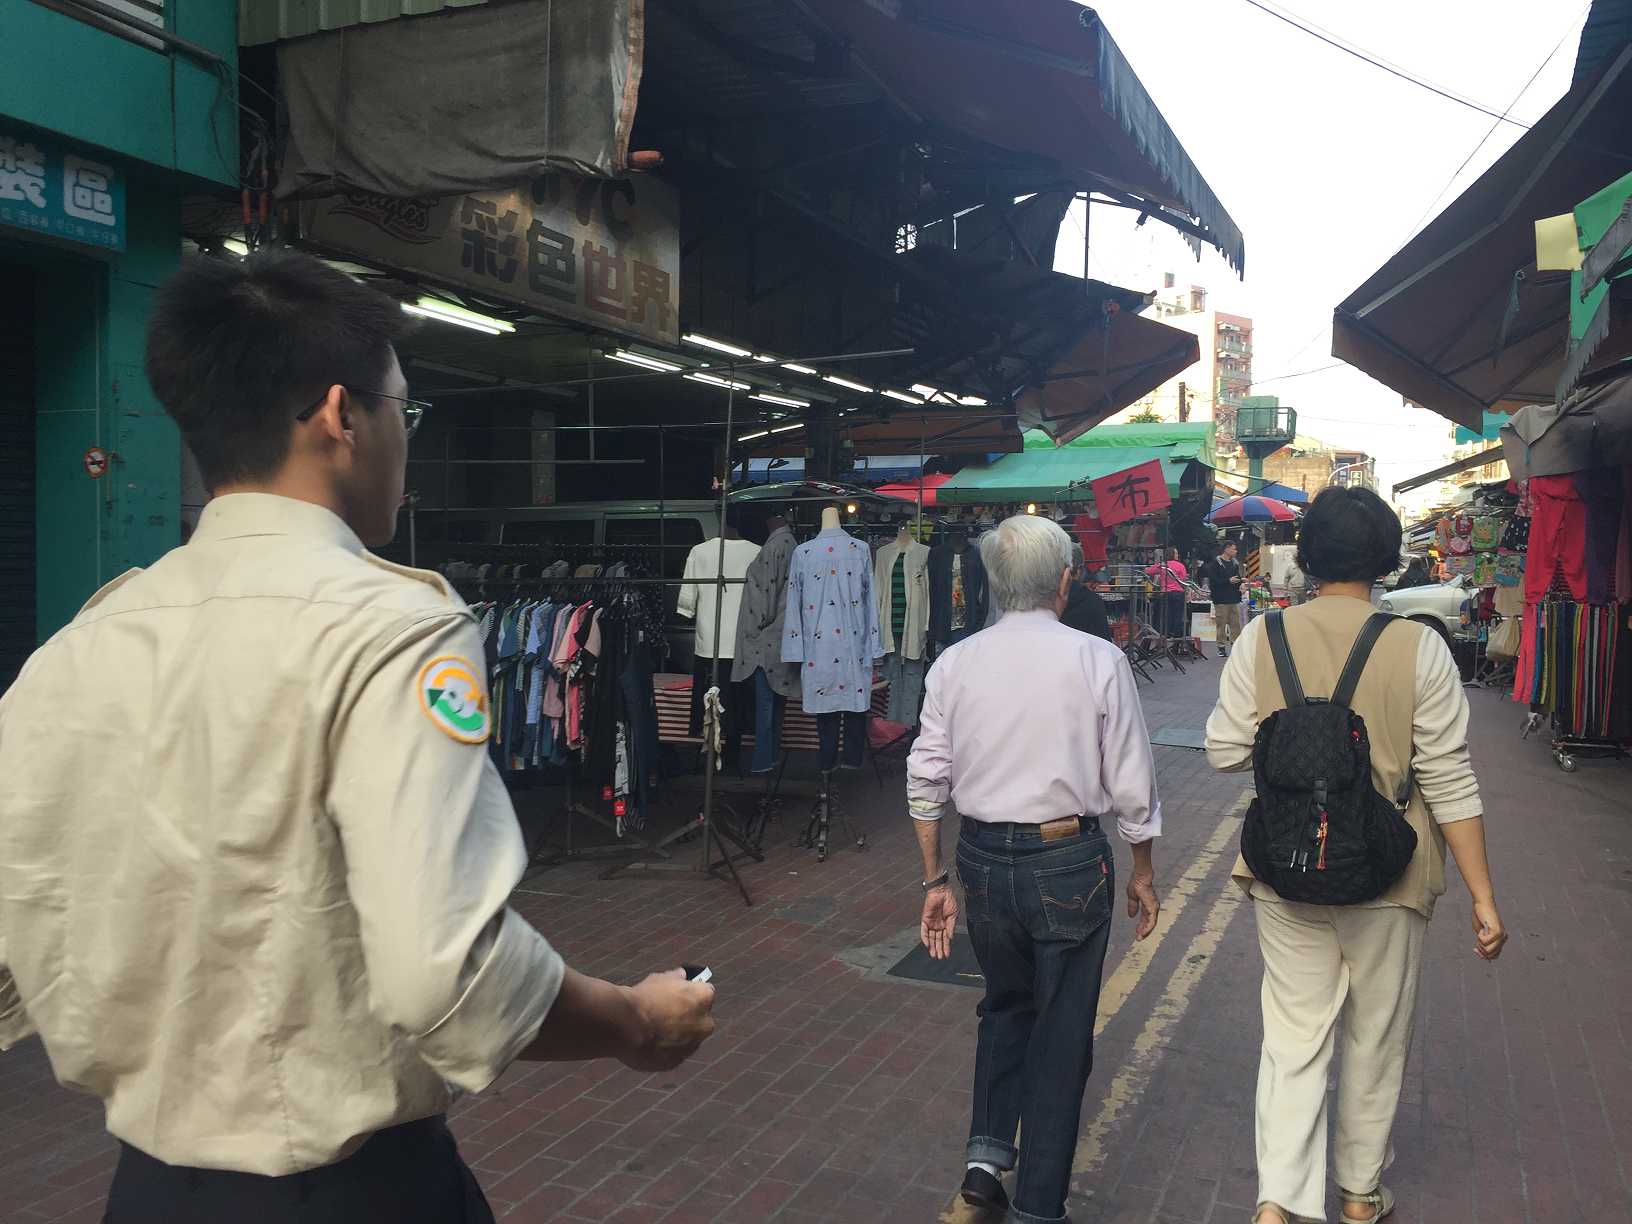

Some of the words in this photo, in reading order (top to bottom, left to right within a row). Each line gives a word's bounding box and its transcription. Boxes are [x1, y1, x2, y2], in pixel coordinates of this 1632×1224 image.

[461, 196, 674, 331] 彩色世界
[1107, 473, 1151, 517] 布
